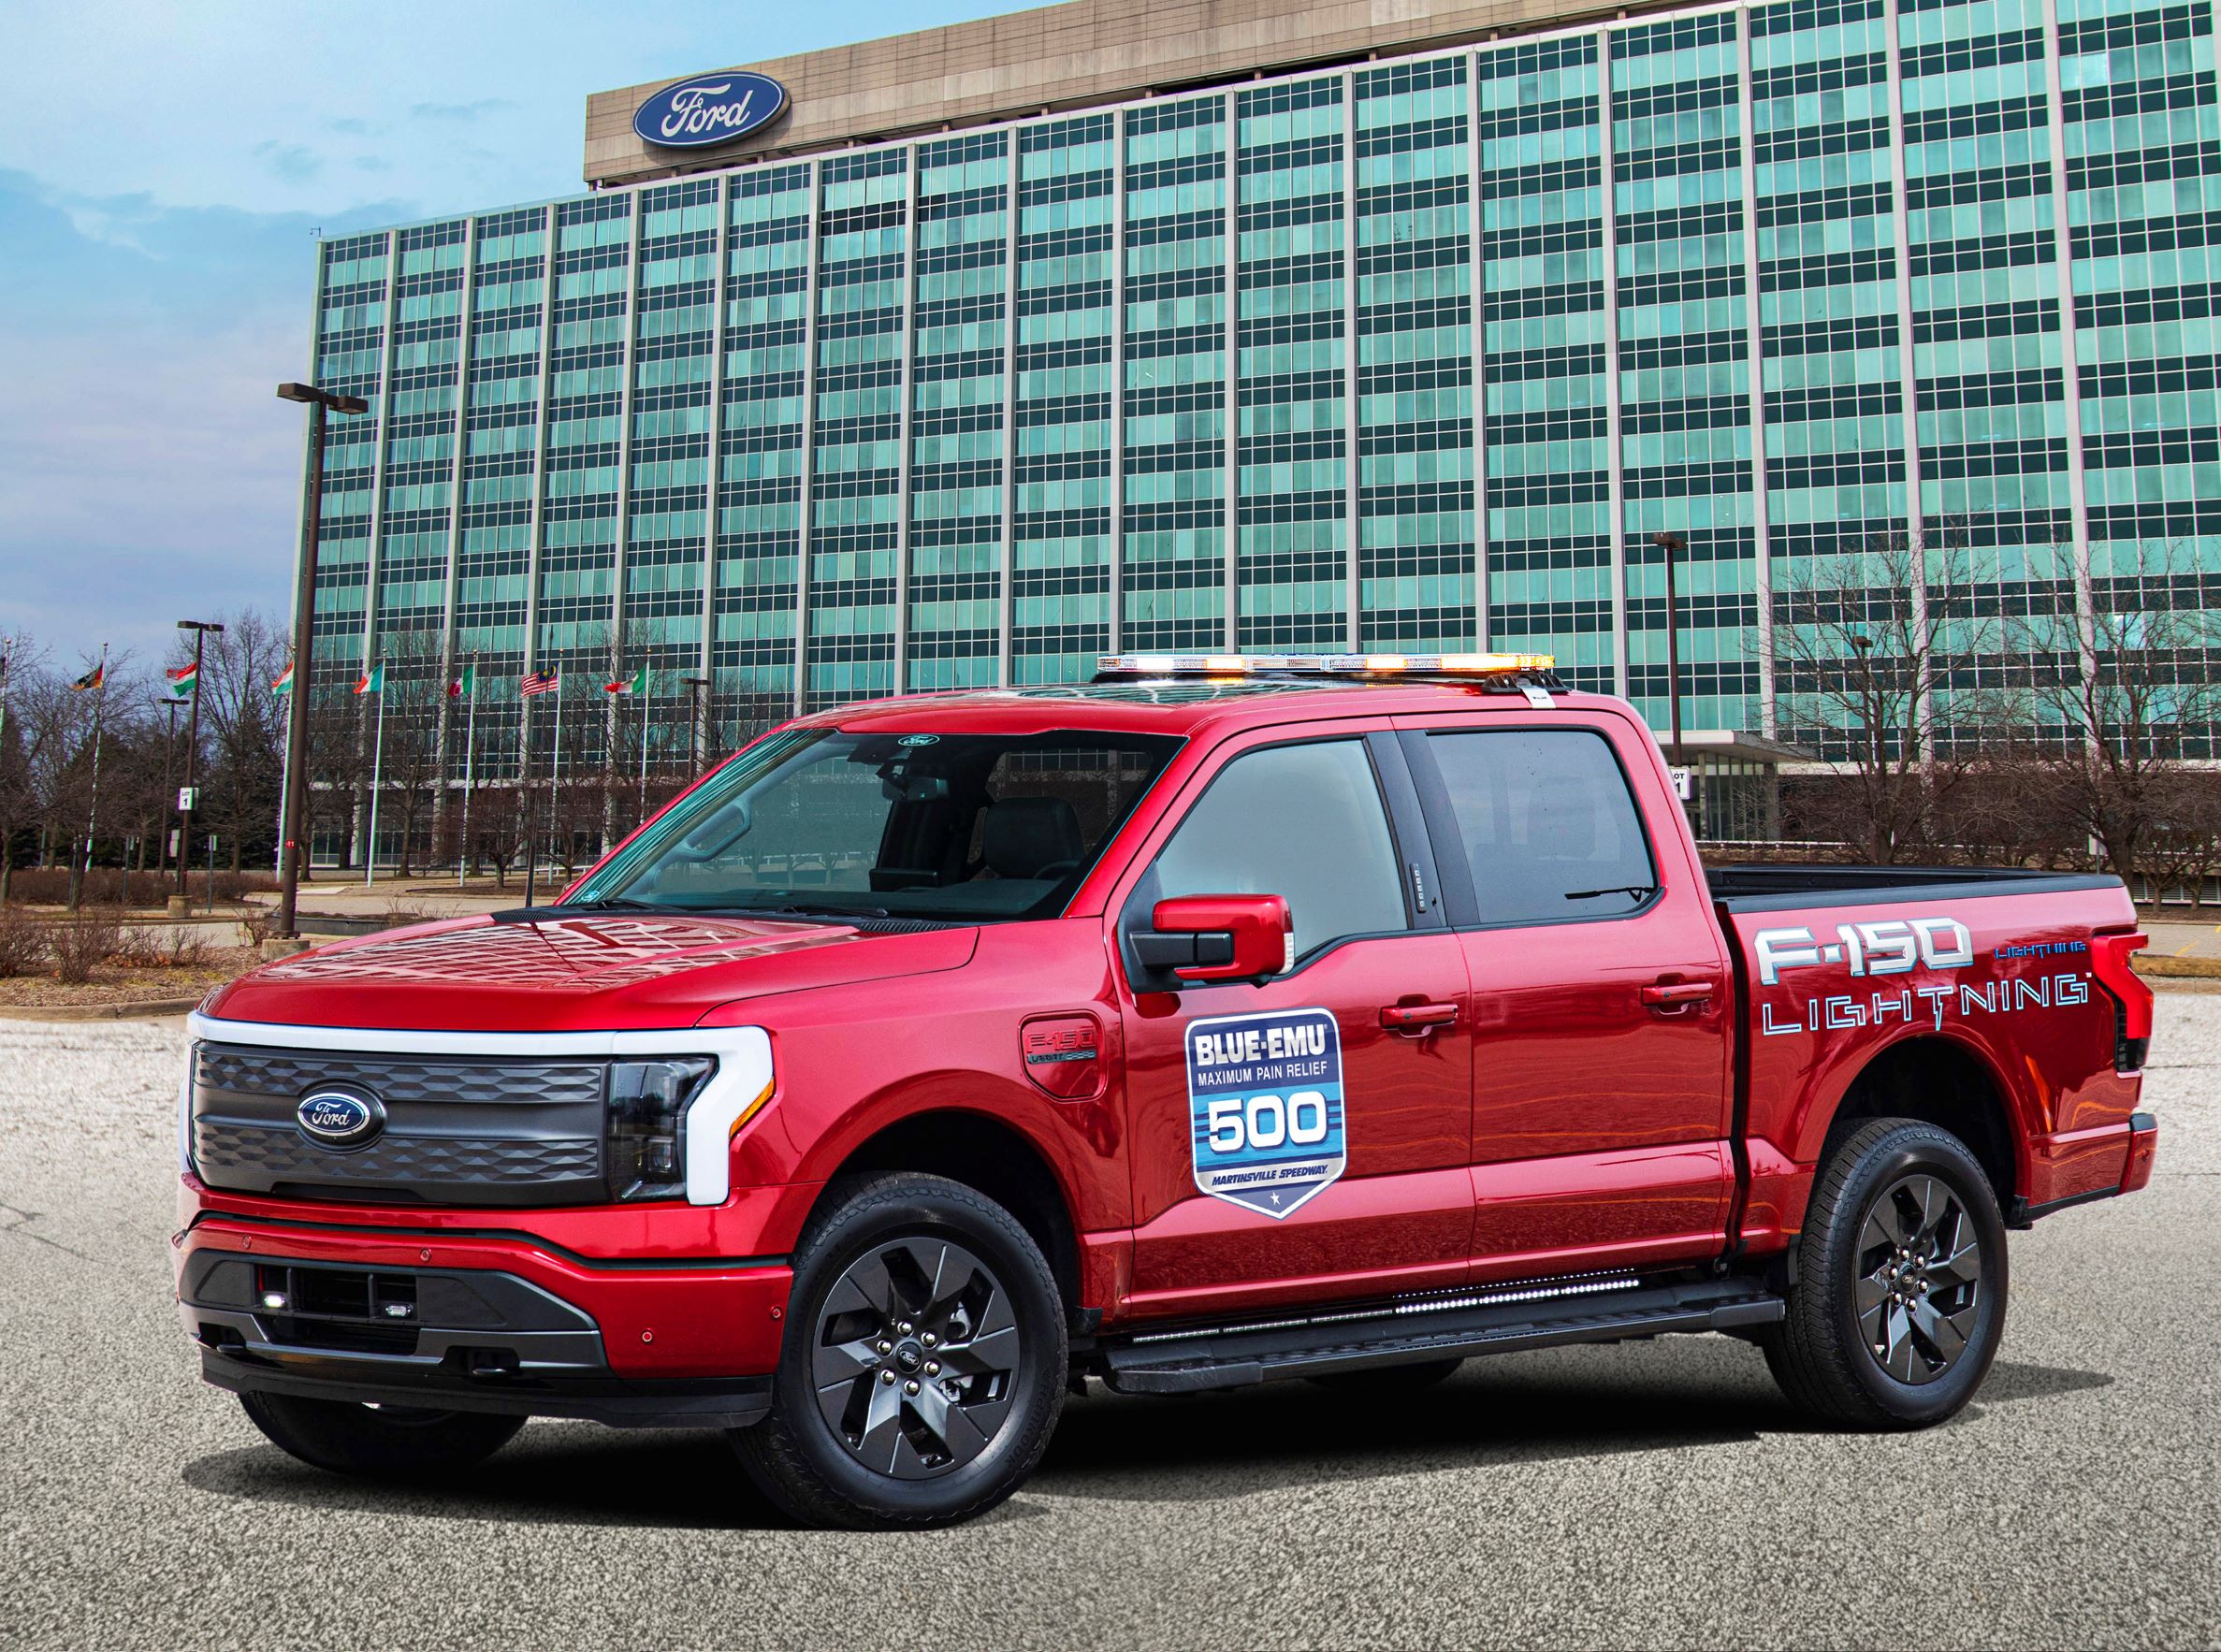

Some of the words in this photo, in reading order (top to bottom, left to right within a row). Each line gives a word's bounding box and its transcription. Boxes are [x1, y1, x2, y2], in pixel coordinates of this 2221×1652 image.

[660, 82, 754, 138] Ford
[182, 797, 188, 806] 1
[1754, 916, 1974, 986] F-150
[1994, 940, 2087, 960] LIGHTNING
[1762, 975, 2087, 1036] LIGHTNING
[1024, 1025, 1096, 1053] F-150
[1195, 1023, 1327, 1066] BLUE-EMU
[1198, 1067, 1252, 1087] MAXIMUM
[1256, 1065, 1283, 1081] PAIN
[1286, 1060, 1328, 1078] RELIEF
[312, 1102, 351, 1126] Ford
[1208, 1091, 1328, 1155] 500
[1212, 1169, 1276, 1186] MARTINSVILLE
